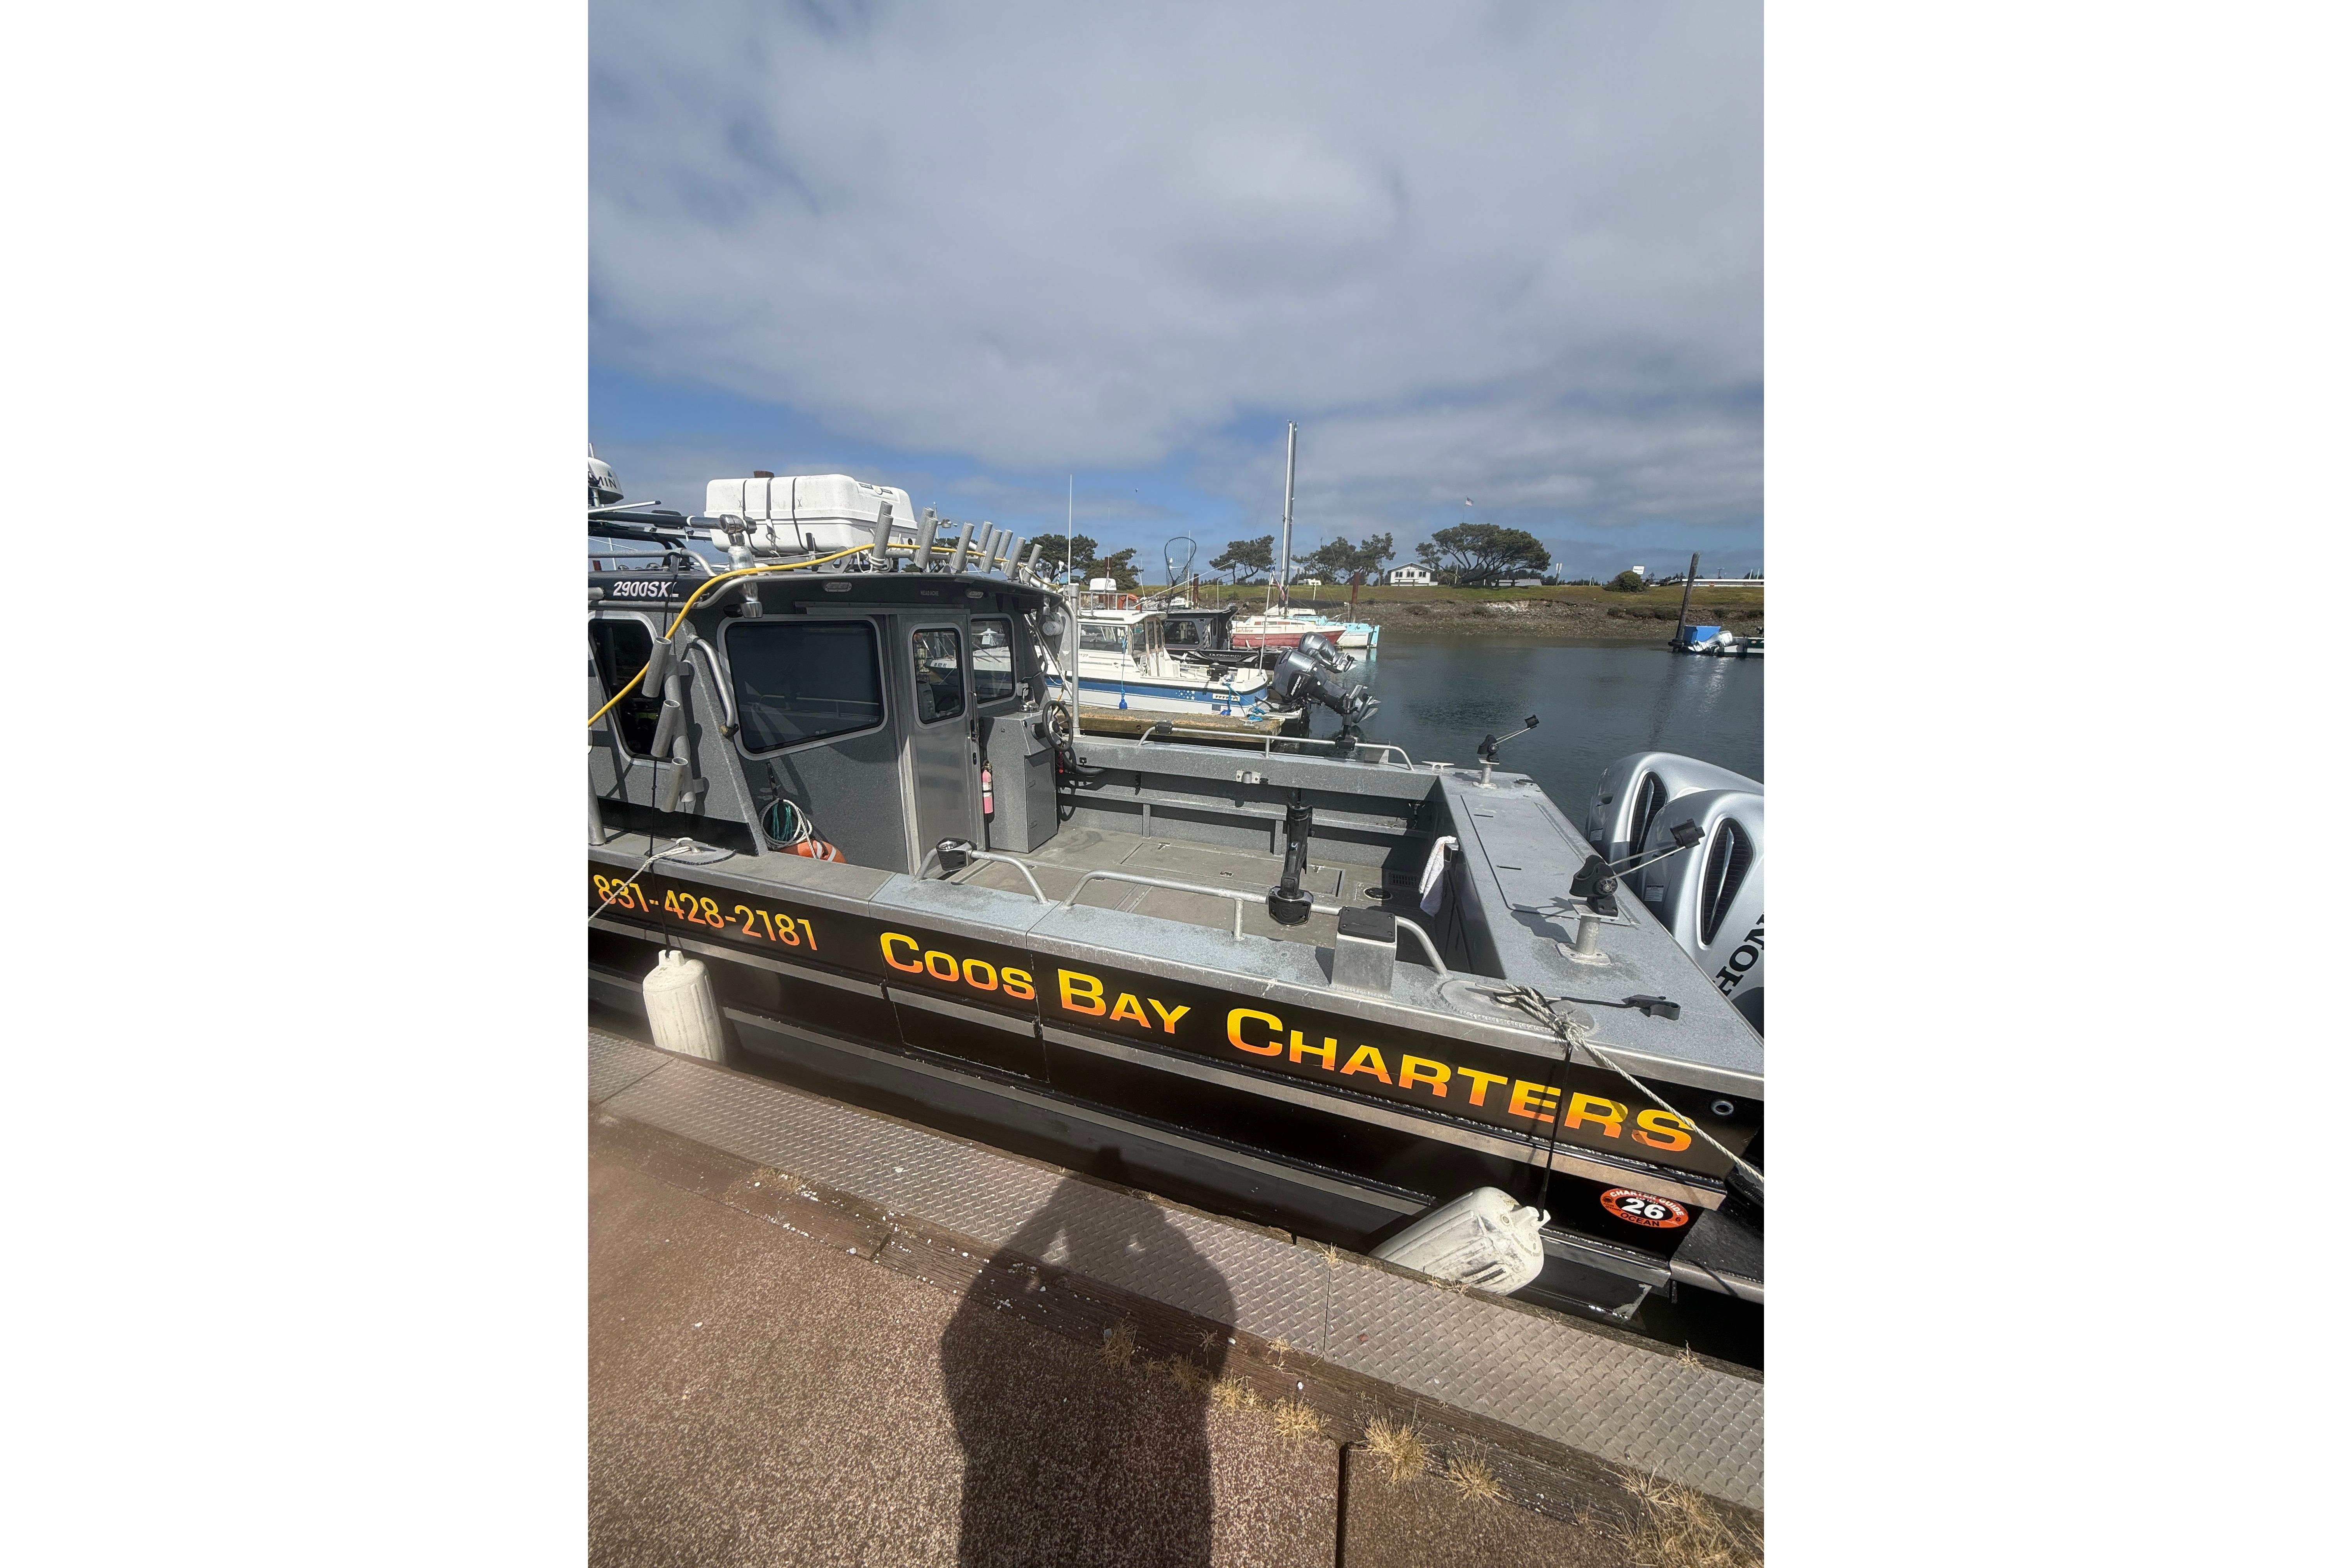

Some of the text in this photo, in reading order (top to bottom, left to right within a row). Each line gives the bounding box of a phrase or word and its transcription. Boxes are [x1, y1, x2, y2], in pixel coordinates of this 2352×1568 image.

[1291, 675, 1301, 696] MERCURY
[593, 875, 817, 950] 831-428-2181
[1610, 1190, 1684, 1216] CHARTER GUIDE
[1621, 1198, 1666, 1219] 26
[1620, 1213, 1659, 1226] OCEAN
